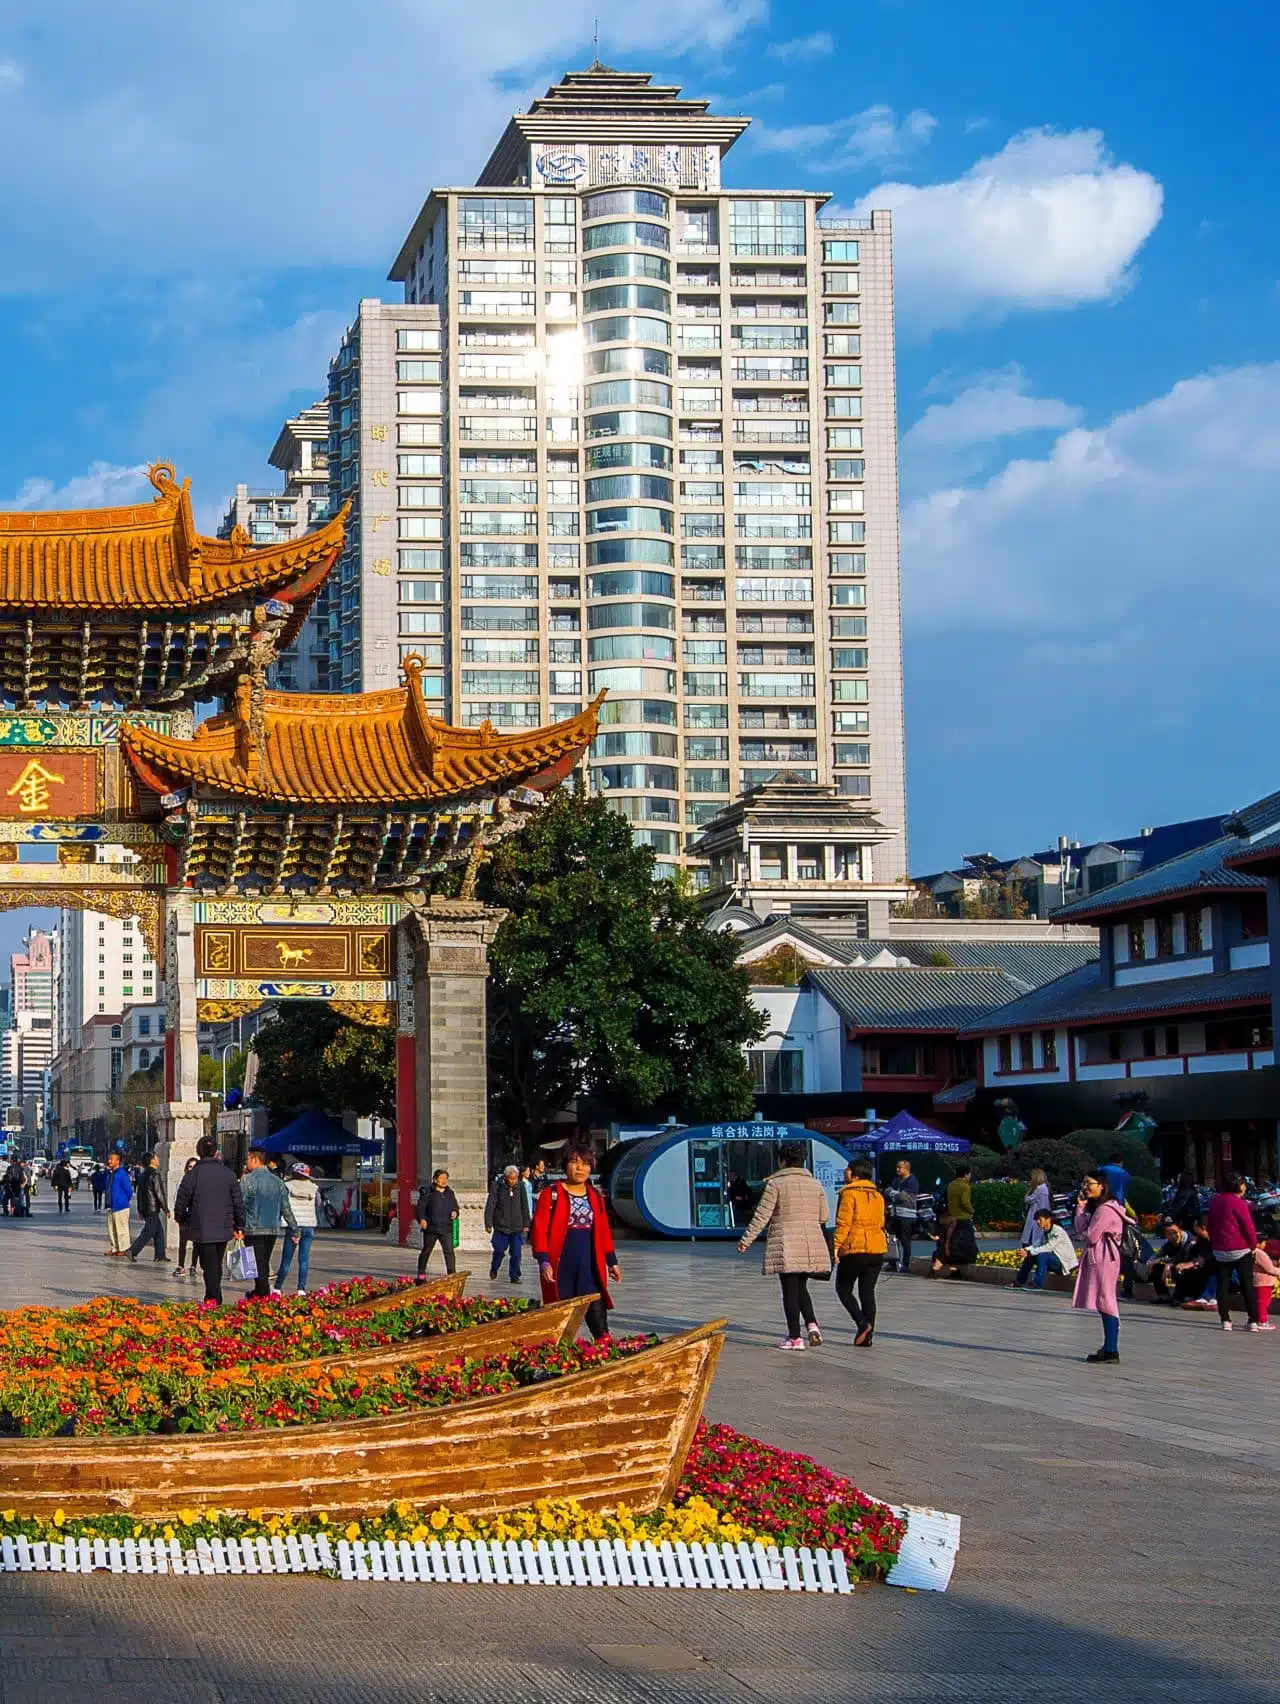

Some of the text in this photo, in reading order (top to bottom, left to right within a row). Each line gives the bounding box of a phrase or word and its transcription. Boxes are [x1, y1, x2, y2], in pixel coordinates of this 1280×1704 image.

[371, 424, 392, 577] 时代广场
[711, 1125, 789, 1139] 综合执法岗亭
